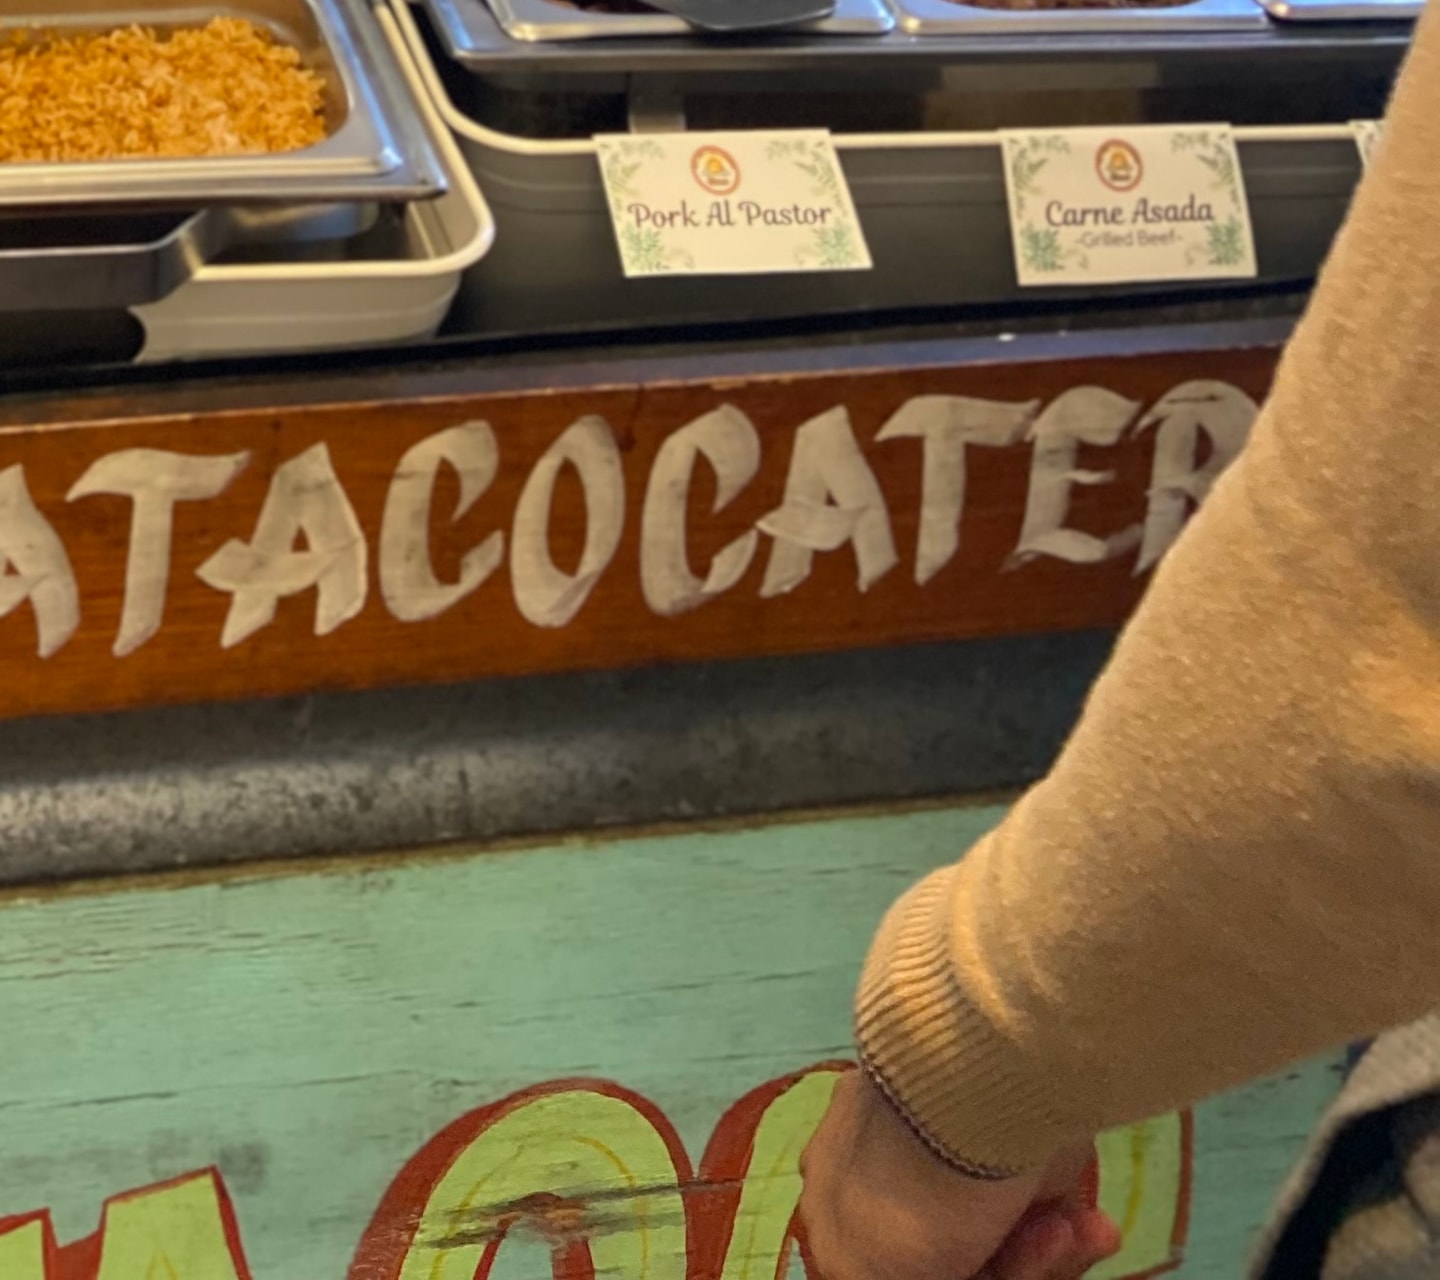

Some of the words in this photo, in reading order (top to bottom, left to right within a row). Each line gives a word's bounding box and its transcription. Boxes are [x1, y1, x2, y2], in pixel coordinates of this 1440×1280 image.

[627, 199, 701, 229] Pork
[705, 199, 735, 227] Al
[737, 201, 832, 226] Pastor
[1045, 200, 1126, 228] Carne
[1131, 194, 1214, 224] Asada
